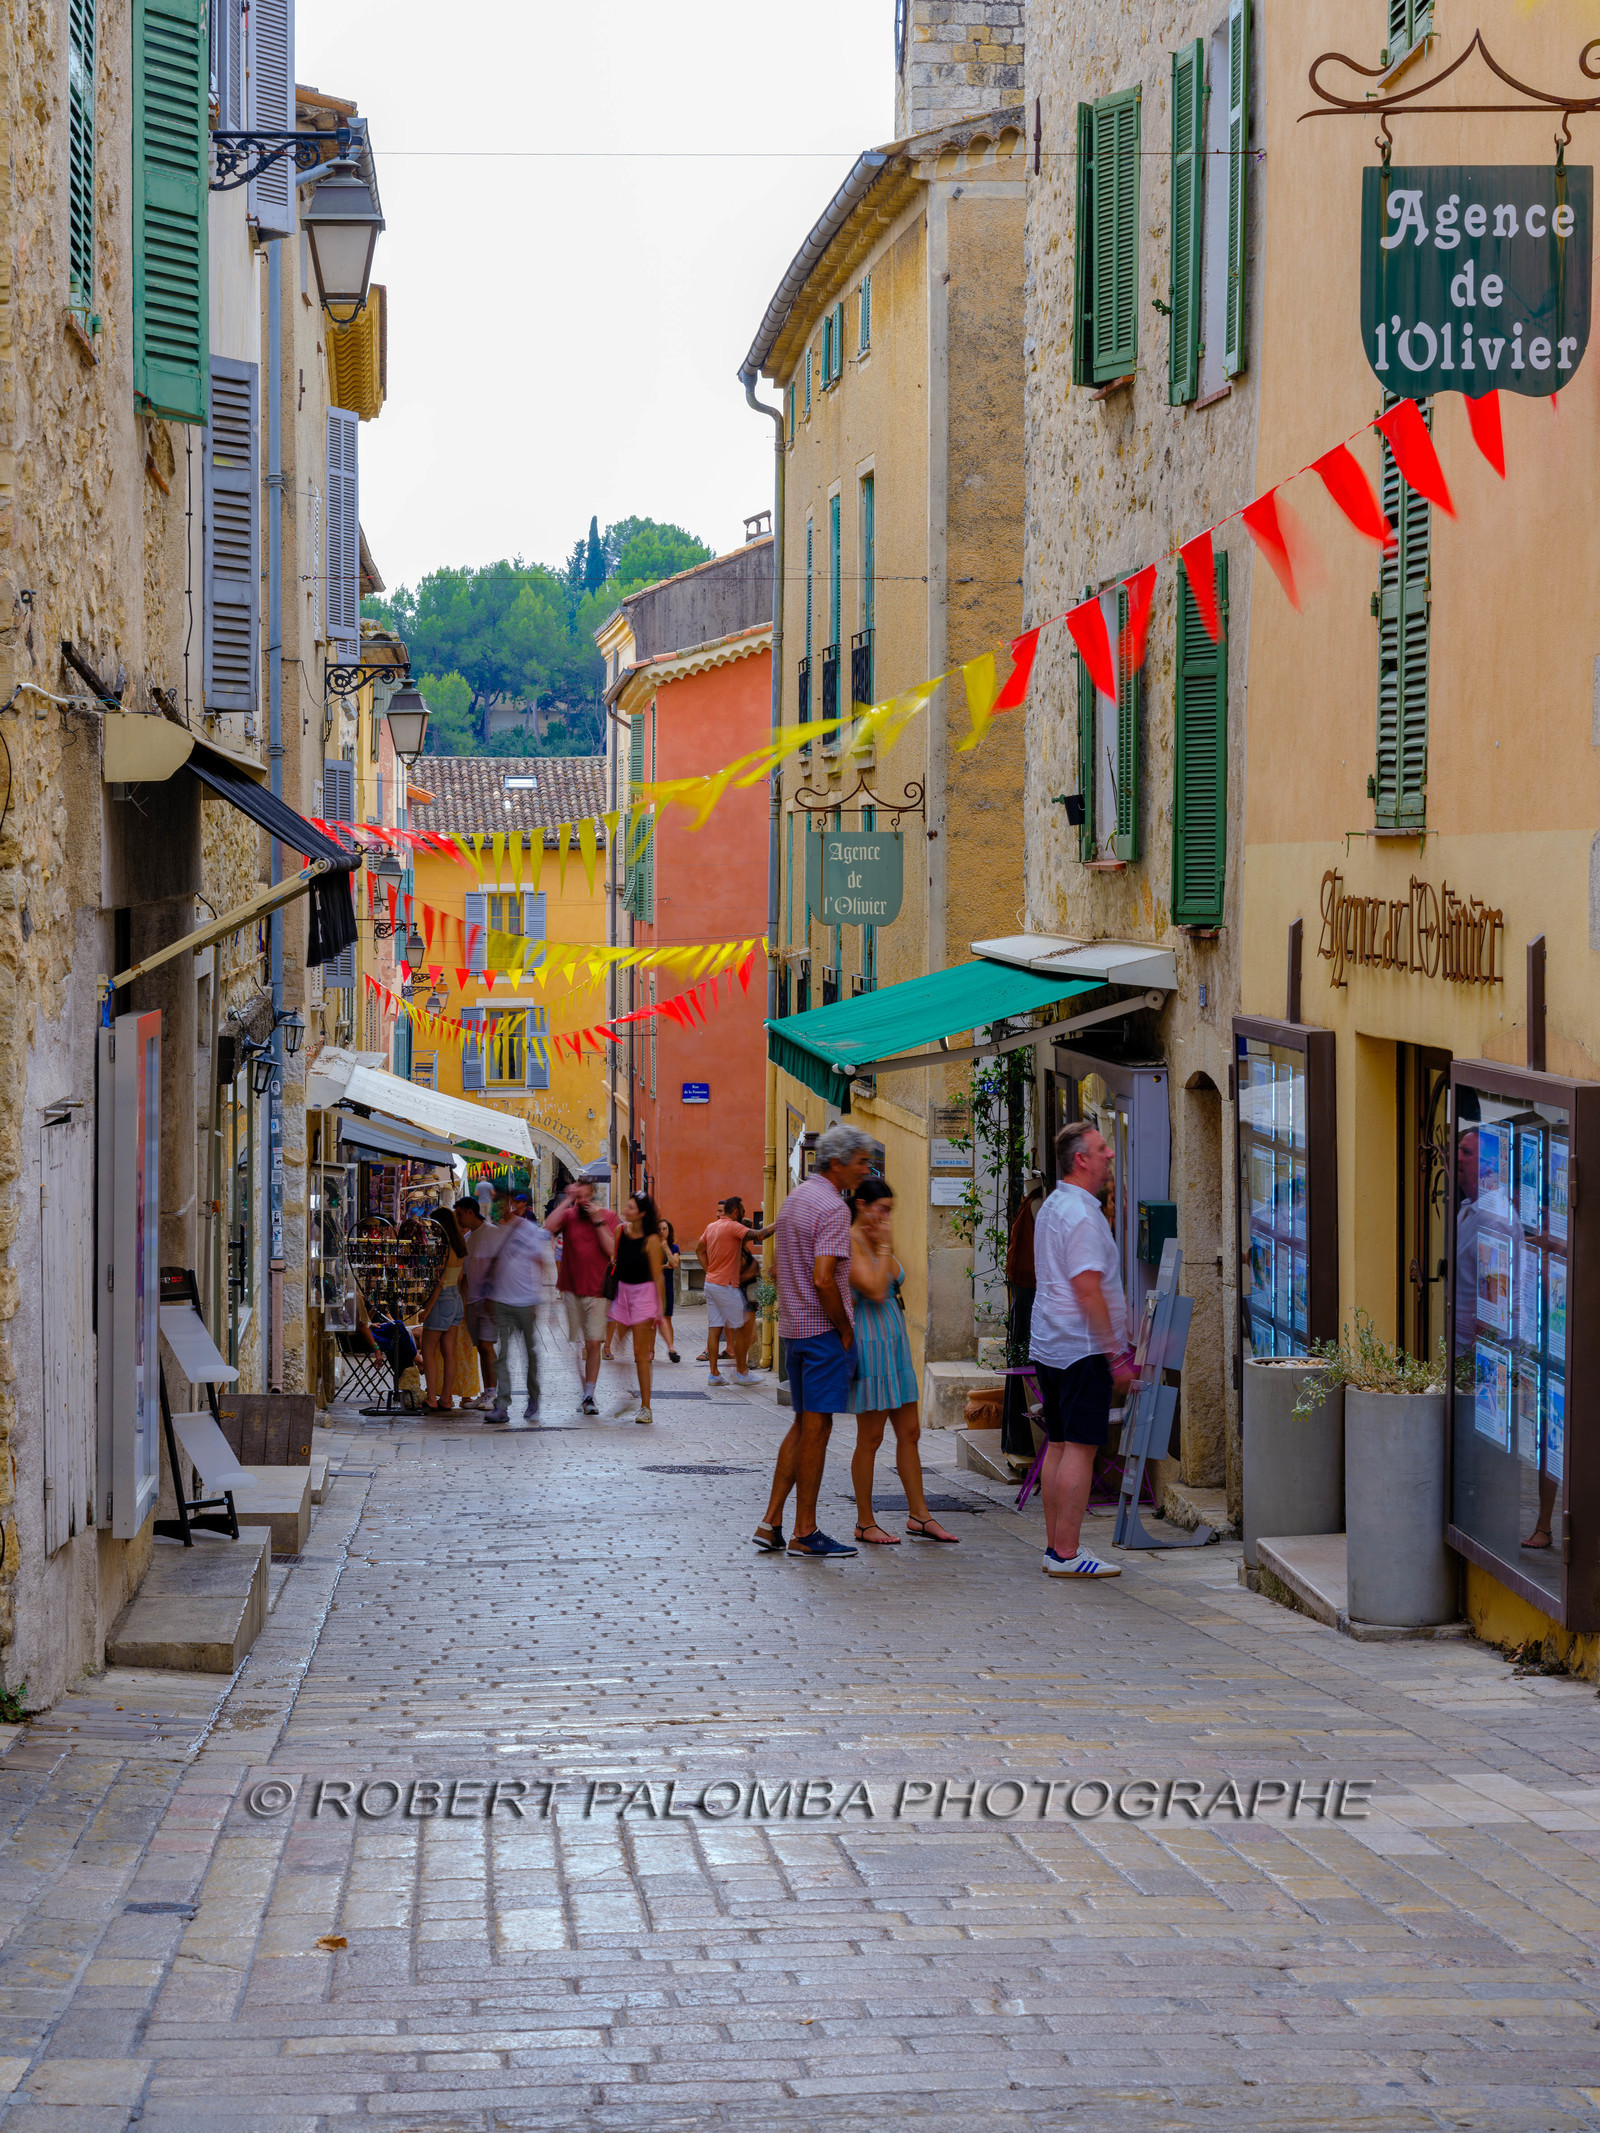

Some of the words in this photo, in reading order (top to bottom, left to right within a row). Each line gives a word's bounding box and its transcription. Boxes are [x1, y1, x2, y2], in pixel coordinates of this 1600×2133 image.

[1380, 189, 1576, 250] Agence
[1450, 259, 1504, 308] de
[1375, 314, 1578, 372] l'Olivier
[828, 842, 881, 865] Agence
[847, 870, 863, 889] de
[824, 896, 887, 915] l'Olivier
